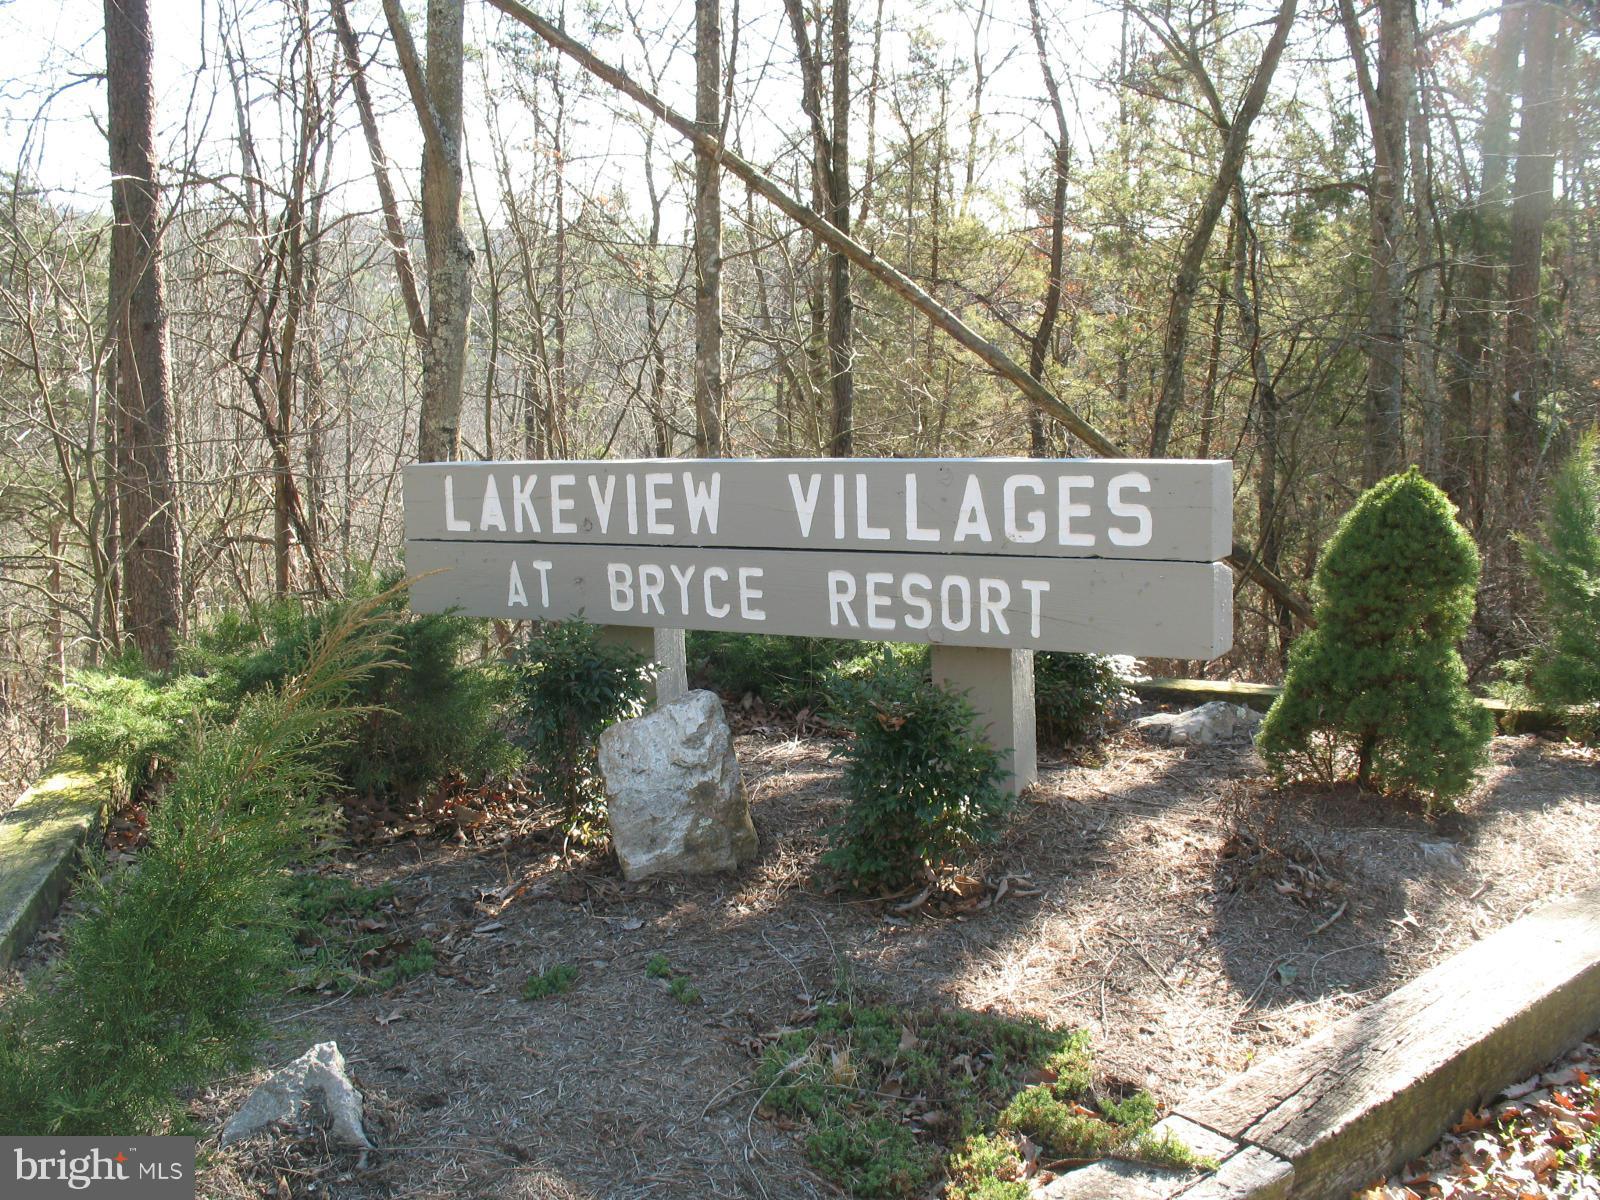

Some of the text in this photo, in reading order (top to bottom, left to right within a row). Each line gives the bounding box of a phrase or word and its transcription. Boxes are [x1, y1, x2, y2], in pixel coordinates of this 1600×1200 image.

[444, 471, 1153, 547] LAKEVIEW VILLAGES
[507, 559, 1051, 638] AT BRYCE RESORT
